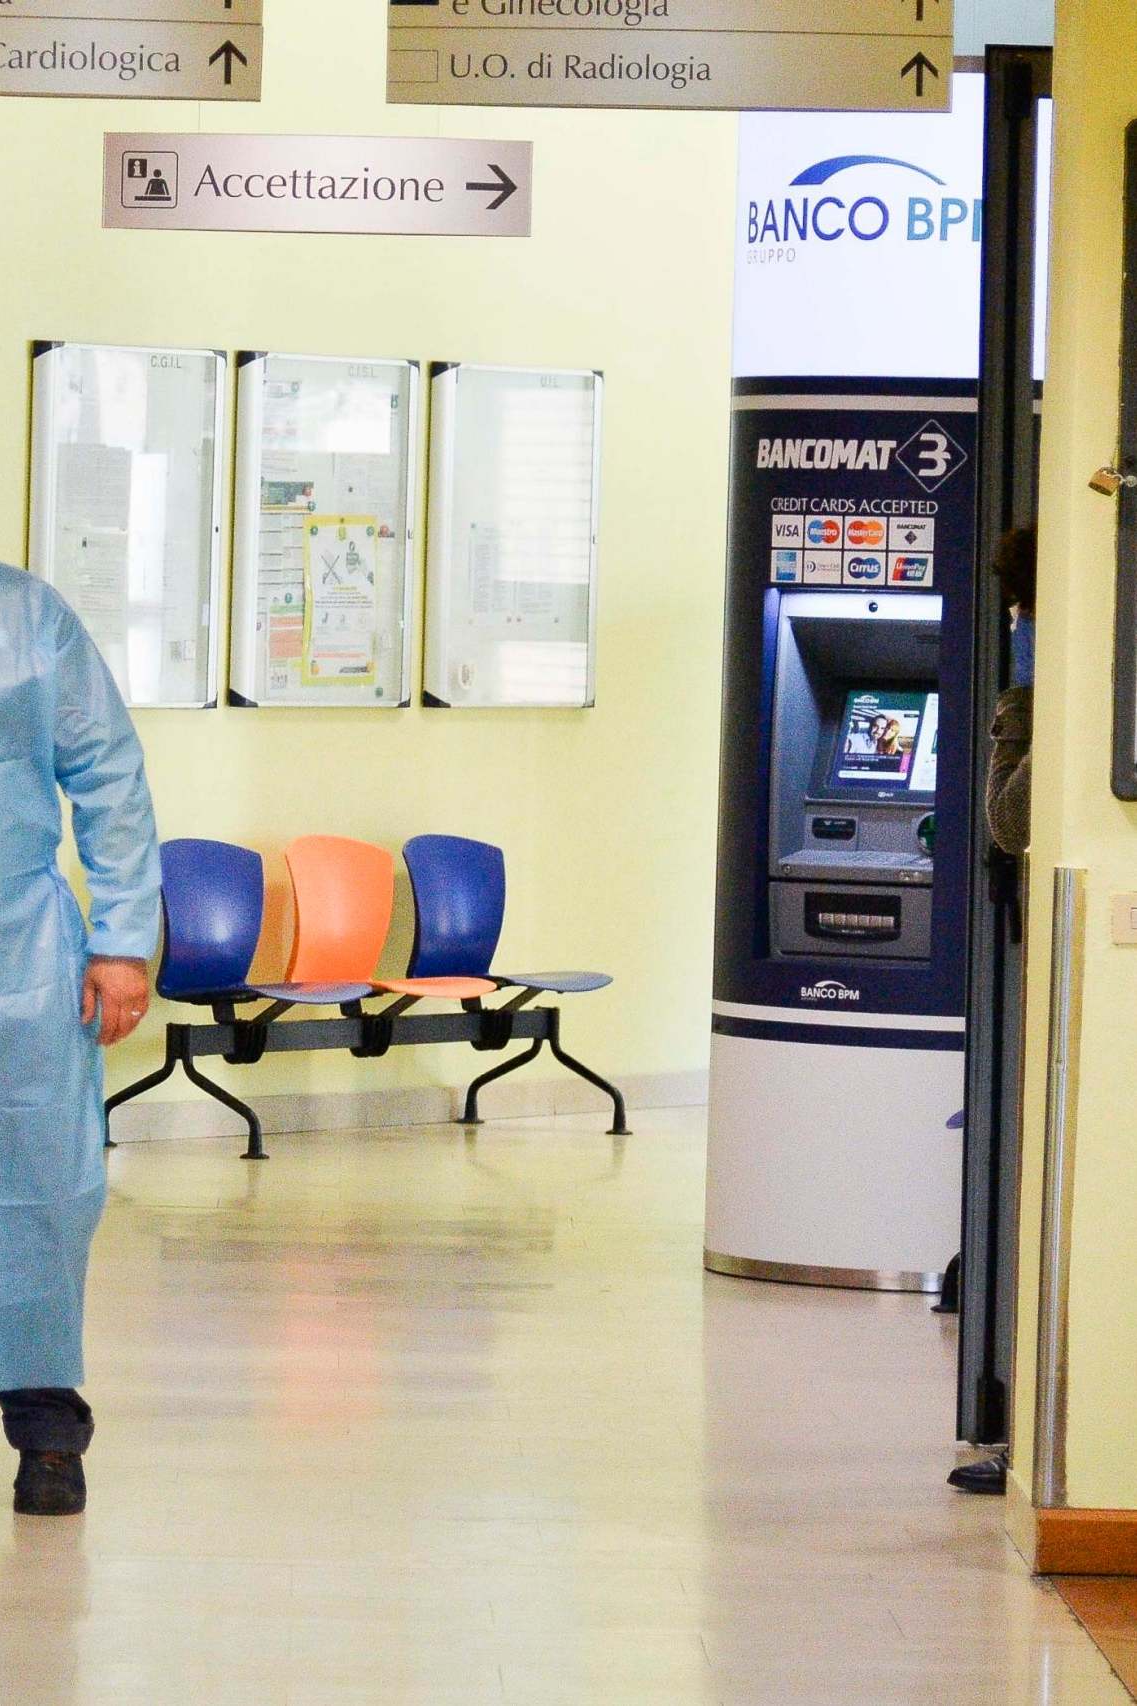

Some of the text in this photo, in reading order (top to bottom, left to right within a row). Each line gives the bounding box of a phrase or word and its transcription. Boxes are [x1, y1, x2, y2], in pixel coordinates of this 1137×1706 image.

[450, 53, 712, 88] U.O. di Radiologia
[194, 164, 445, 202] Accettazione
[748, 196, 890, 244] BANCO
[747, 248, 796, 264] GRUPPO
[757, 439, 897, 470] BANCOMAT
[771, 498, 939, 515] CREDIT CARDS ACCEPTED
[776, 525, 800, 537] VISA
[850, 562, 879, 574] Cirrus
[800, 986, 860, 1000] BANCO BPM
